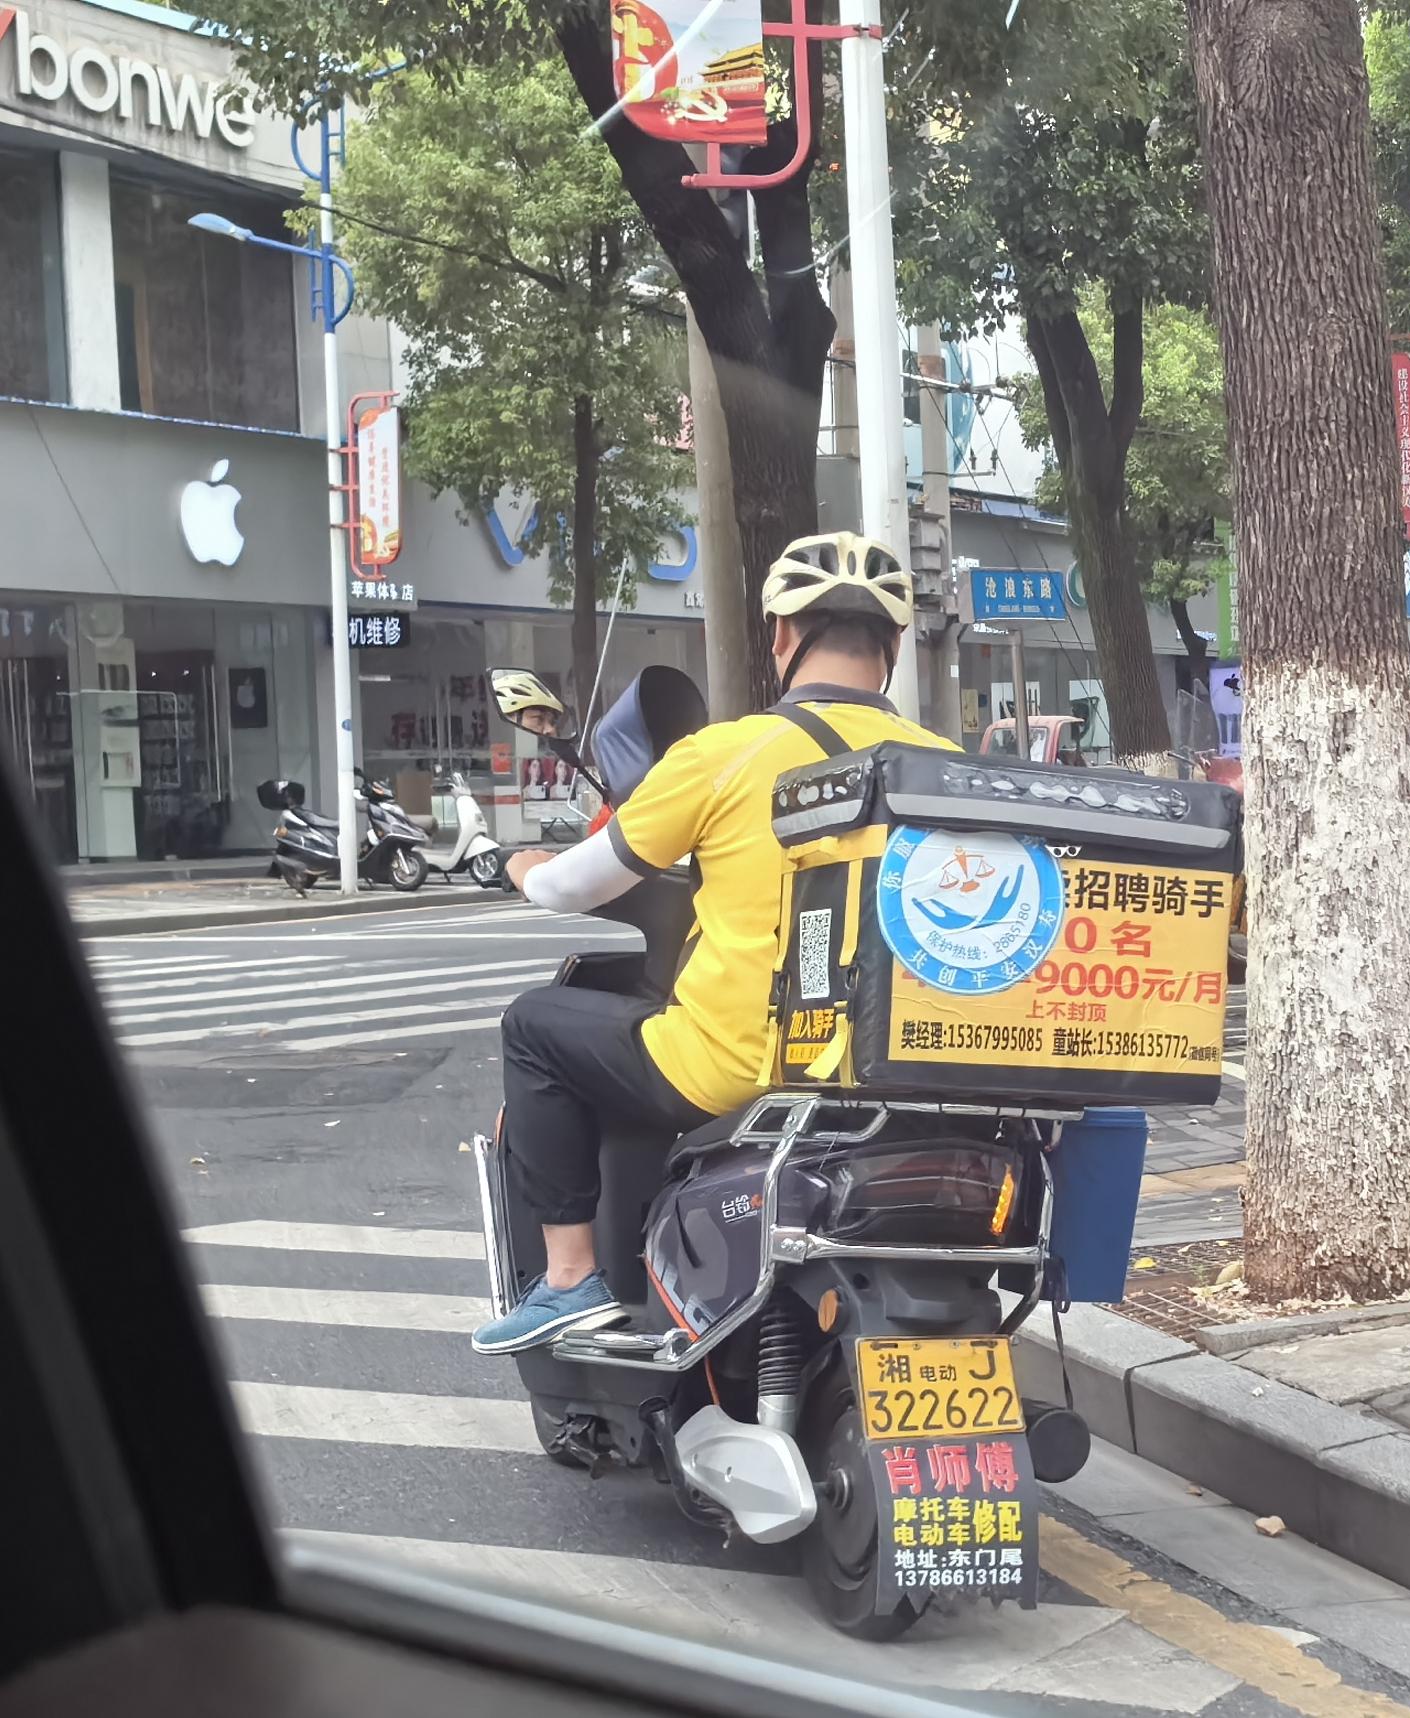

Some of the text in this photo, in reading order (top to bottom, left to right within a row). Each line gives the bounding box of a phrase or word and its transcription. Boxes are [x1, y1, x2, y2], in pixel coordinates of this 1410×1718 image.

[985, 575, 1053, 599] 沧浪东路
[1024, 1000, 1108, 1022] 上不封顶
[901, 1018, 1043, 1052] 樊经理:15367995085
[1052, 1026, 1189, 1059] 童站长:15386135772
[879, 1349, 997, 1383] 湘 电动 J
[867, 1386, 1018, 1433] 322622
[882, 1441, 1019, 1496] 肖师傅
[893, 1496, 971, 1523] 摩托车
[972, 1499, 1023, 1543] 修配
[894, 1522, 971, 1547] 电动车
[894, 1567, 1023, 1587] 13786613184
